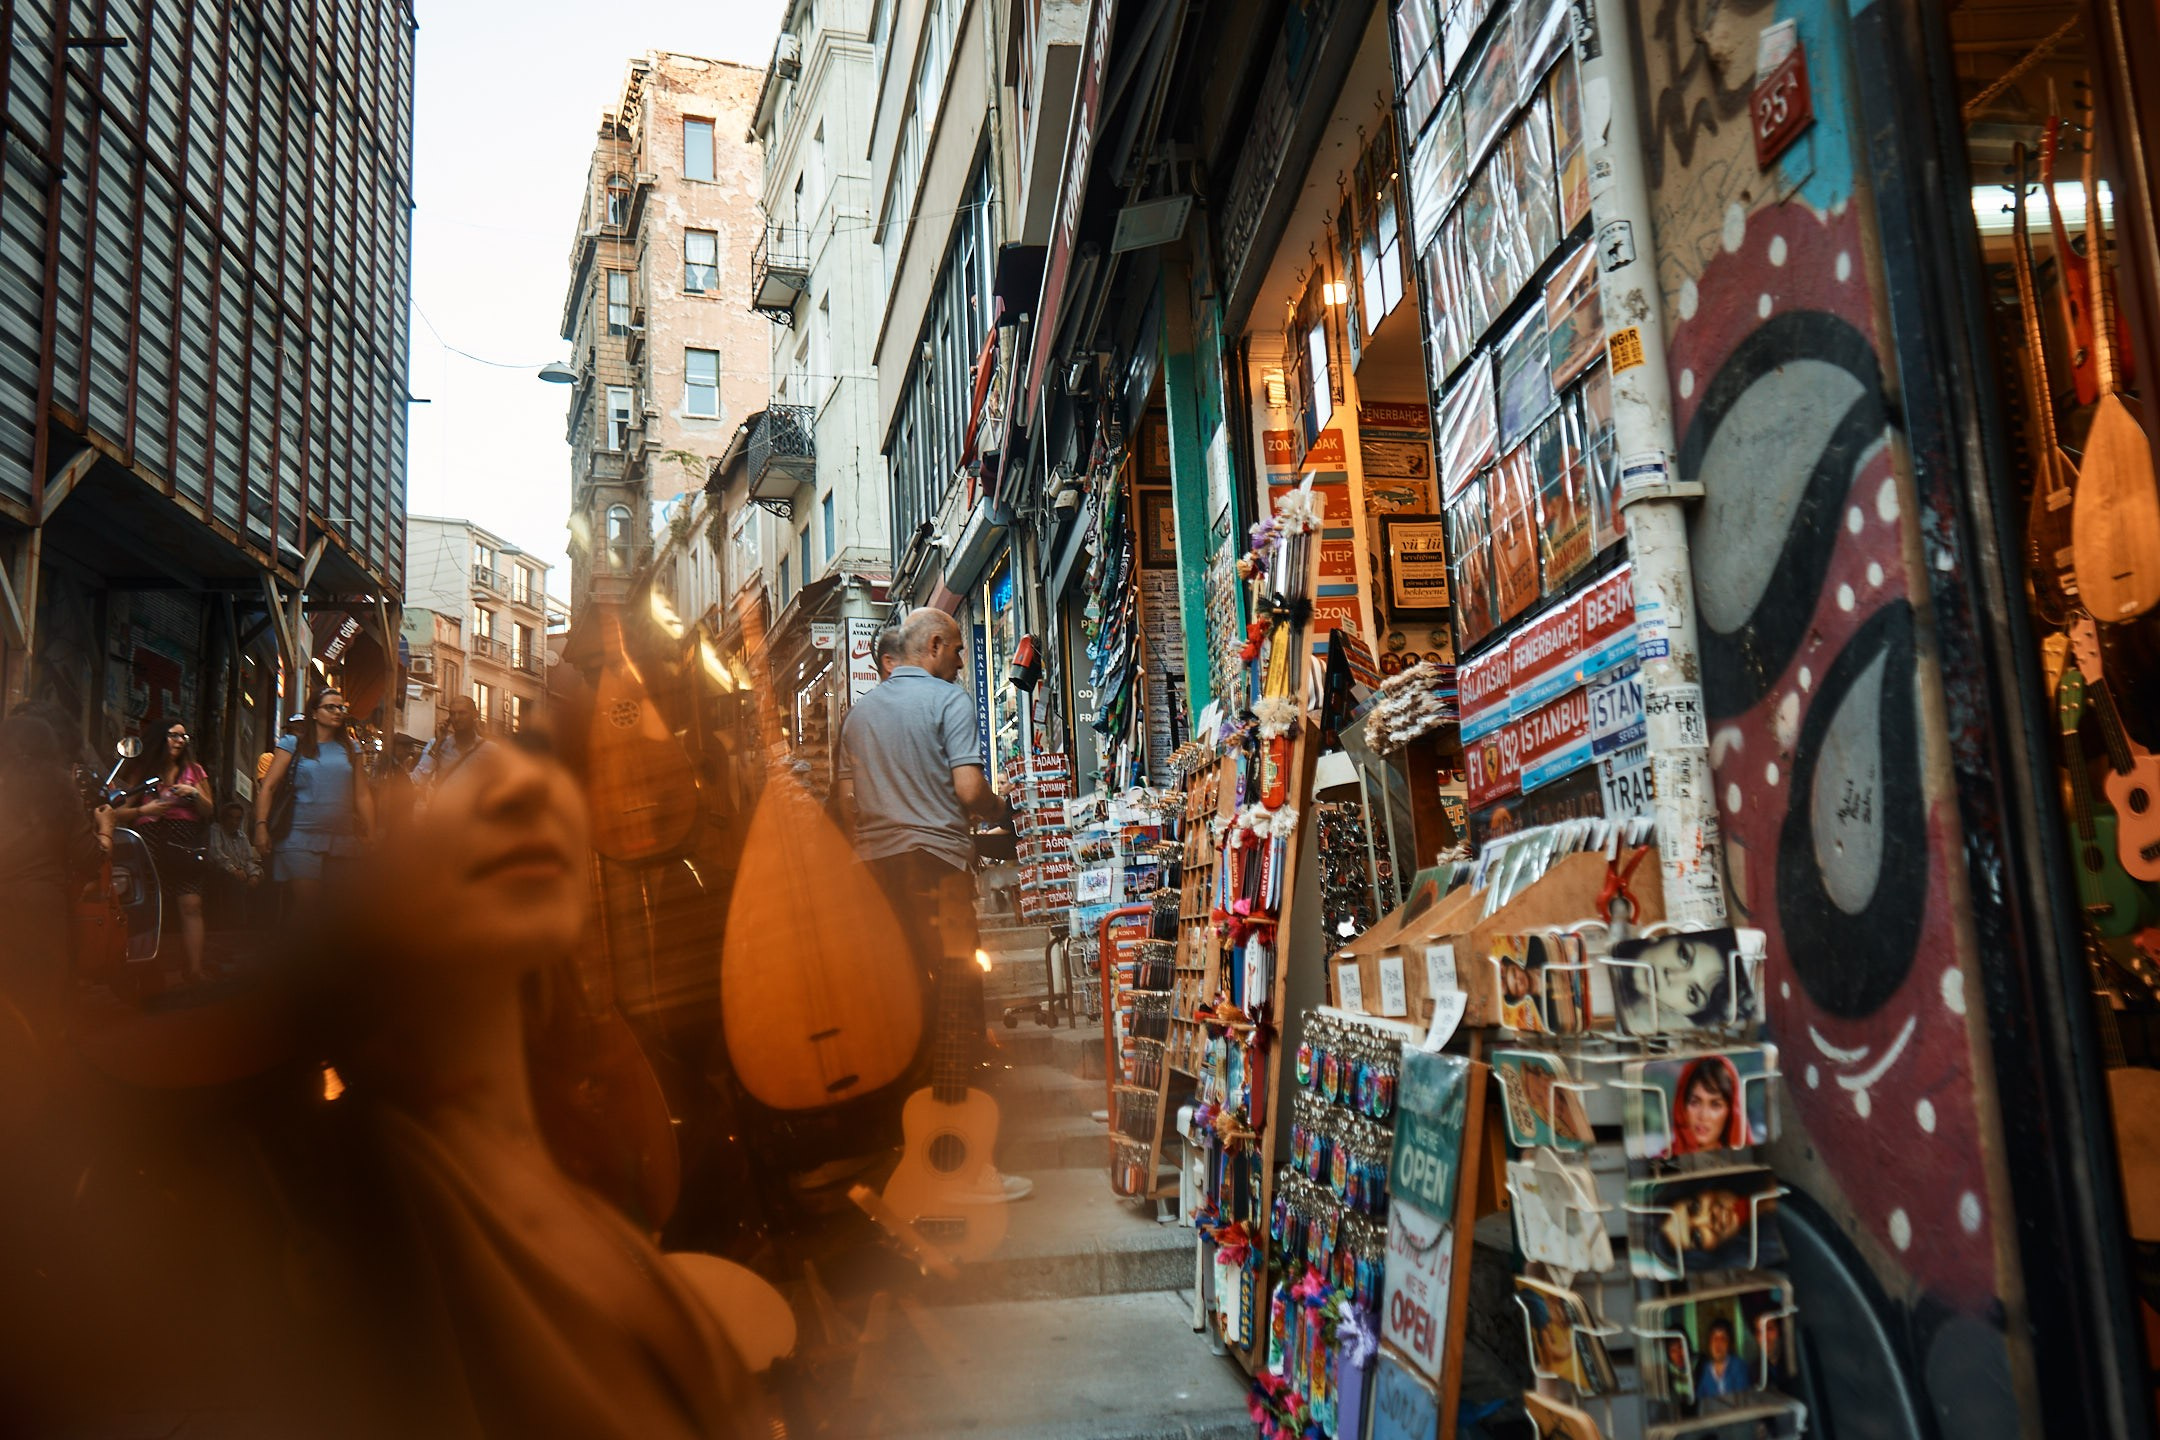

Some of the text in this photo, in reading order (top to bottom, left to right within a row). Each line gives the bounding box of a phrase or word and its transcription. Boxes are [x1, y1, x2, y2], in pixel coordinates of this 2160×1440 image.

[1760, 83, 1788, 138] 25
[1063, 101, 1091, 249] TOWER
[324, 636, 346, 661] MERT
[1513, 613, 1579, 673] FENERBAHÇE
[852, 672, 878, 681] PUMA
[1520, 695, 1589, 754] İSTANBUL
[1592, 681, 1644, 729] İSTAN
[1037, 755, 1061, 767] ADANA
[1468, 749, 1484, 791] F1
[1606, 766, 1655, 812] TRAB
[1400, 1144, 1449, 1208] OPEN
[1390, 1289, 1438, 1362] OPEN
